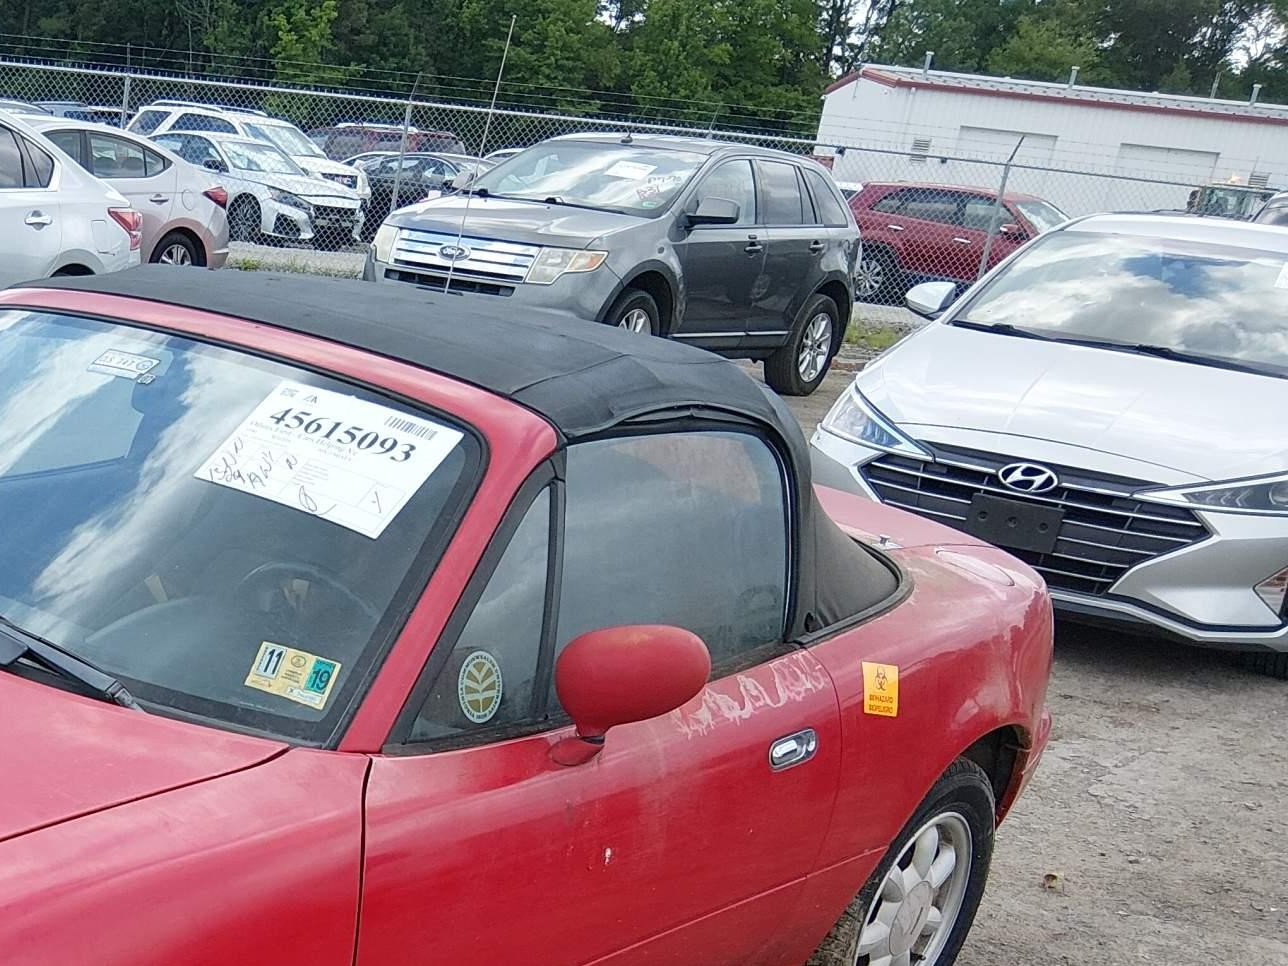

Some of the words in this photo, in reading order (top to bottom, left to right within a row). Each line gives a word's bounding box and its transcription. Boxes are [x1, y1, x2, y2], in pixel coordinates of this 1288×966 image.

[269, 406, 417, 464] 45615093
[263, 649, 284, 675] 11
[311, 669, 331, 690] 19
